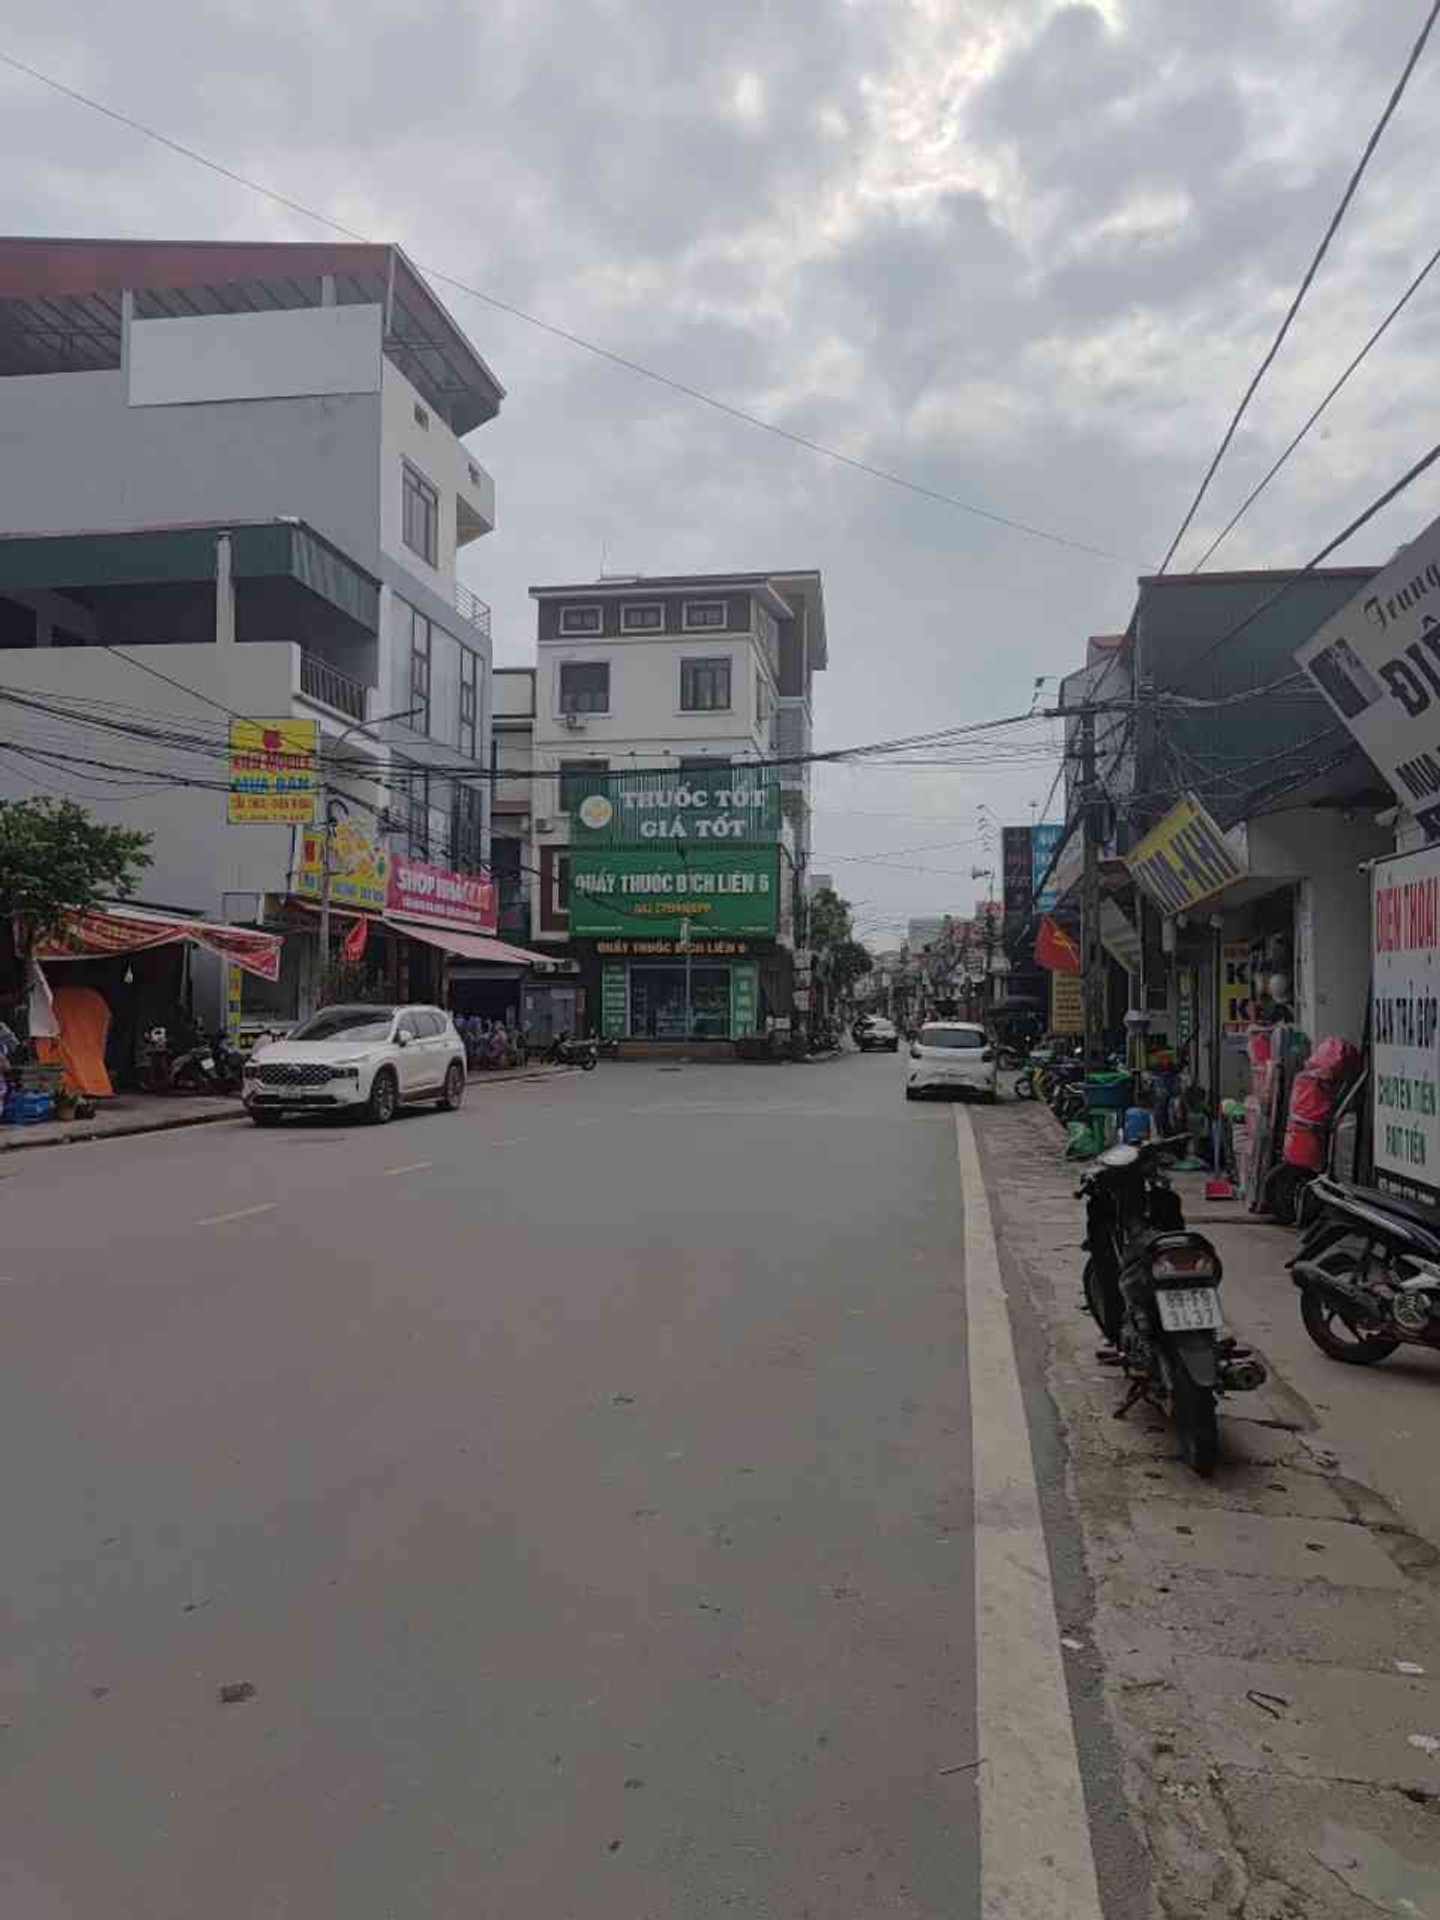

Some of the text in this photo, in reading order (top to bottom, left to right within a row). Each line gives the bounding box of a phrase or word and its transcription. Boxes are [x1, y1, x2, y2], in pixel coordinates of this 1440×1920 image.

[622, 782, 708, 807] THUỐC
[641, 812, 745, 837] GIÁ TỐT
[397, 867, 435, 896] SHOP
